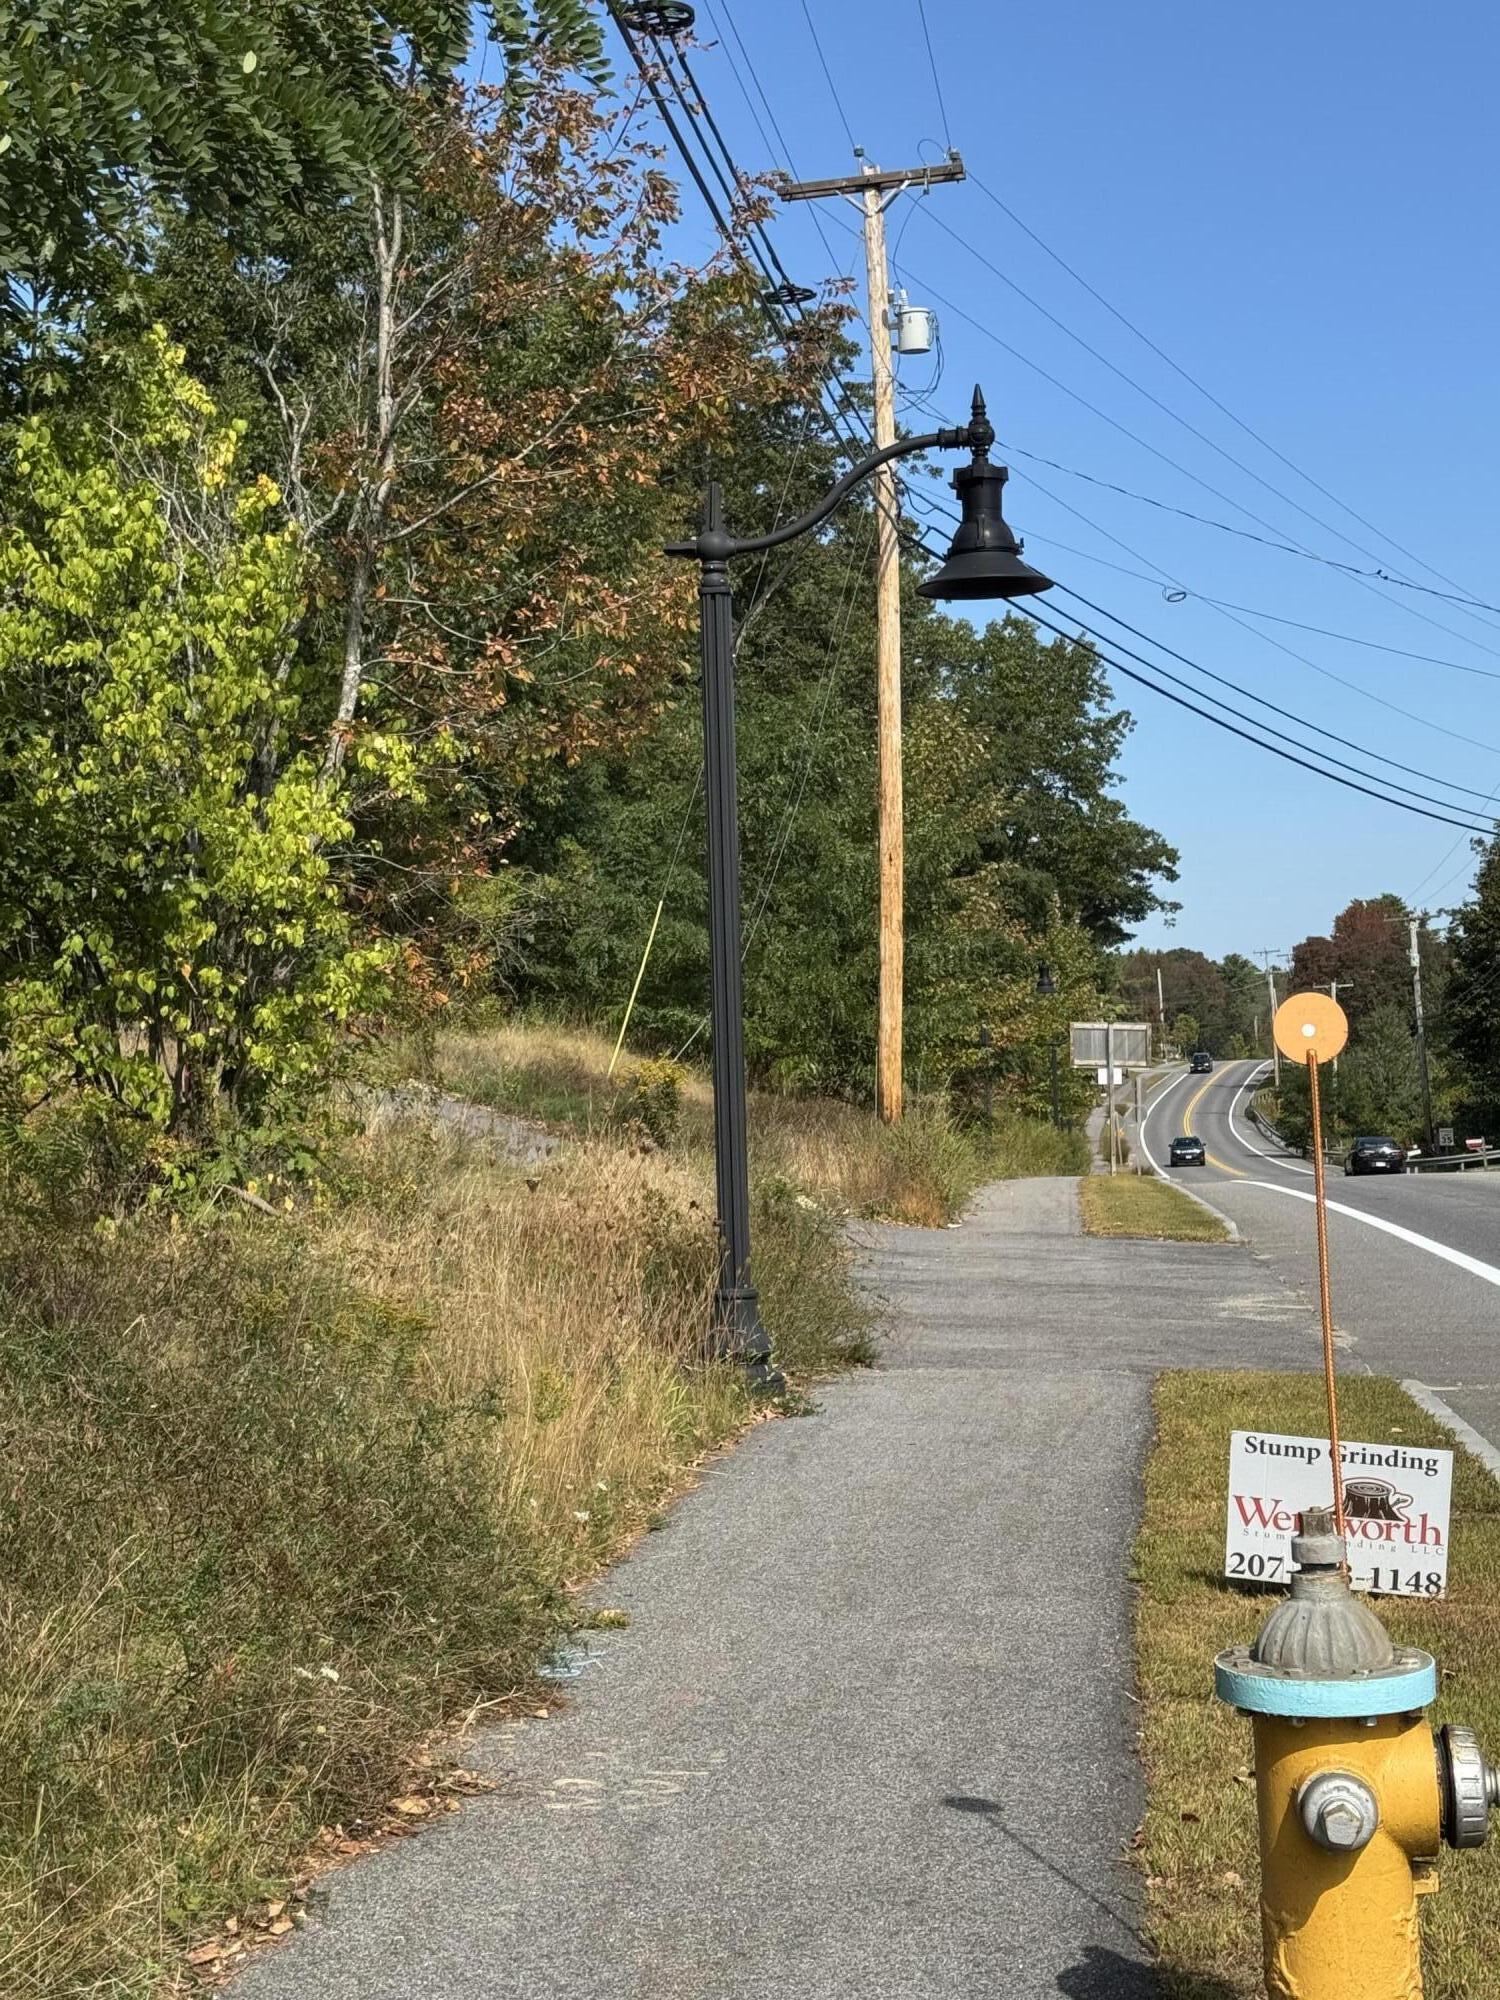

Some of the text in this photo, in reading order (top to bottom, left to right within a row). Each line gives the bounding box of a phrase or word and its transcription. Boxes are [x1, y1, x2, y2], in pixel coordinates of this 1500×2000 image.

[1244, 1435, 1321, 1465] Stump
[1242, 1528, 1285, 1540] Stum
[1411, 1544, 1445, 1556] LLC
